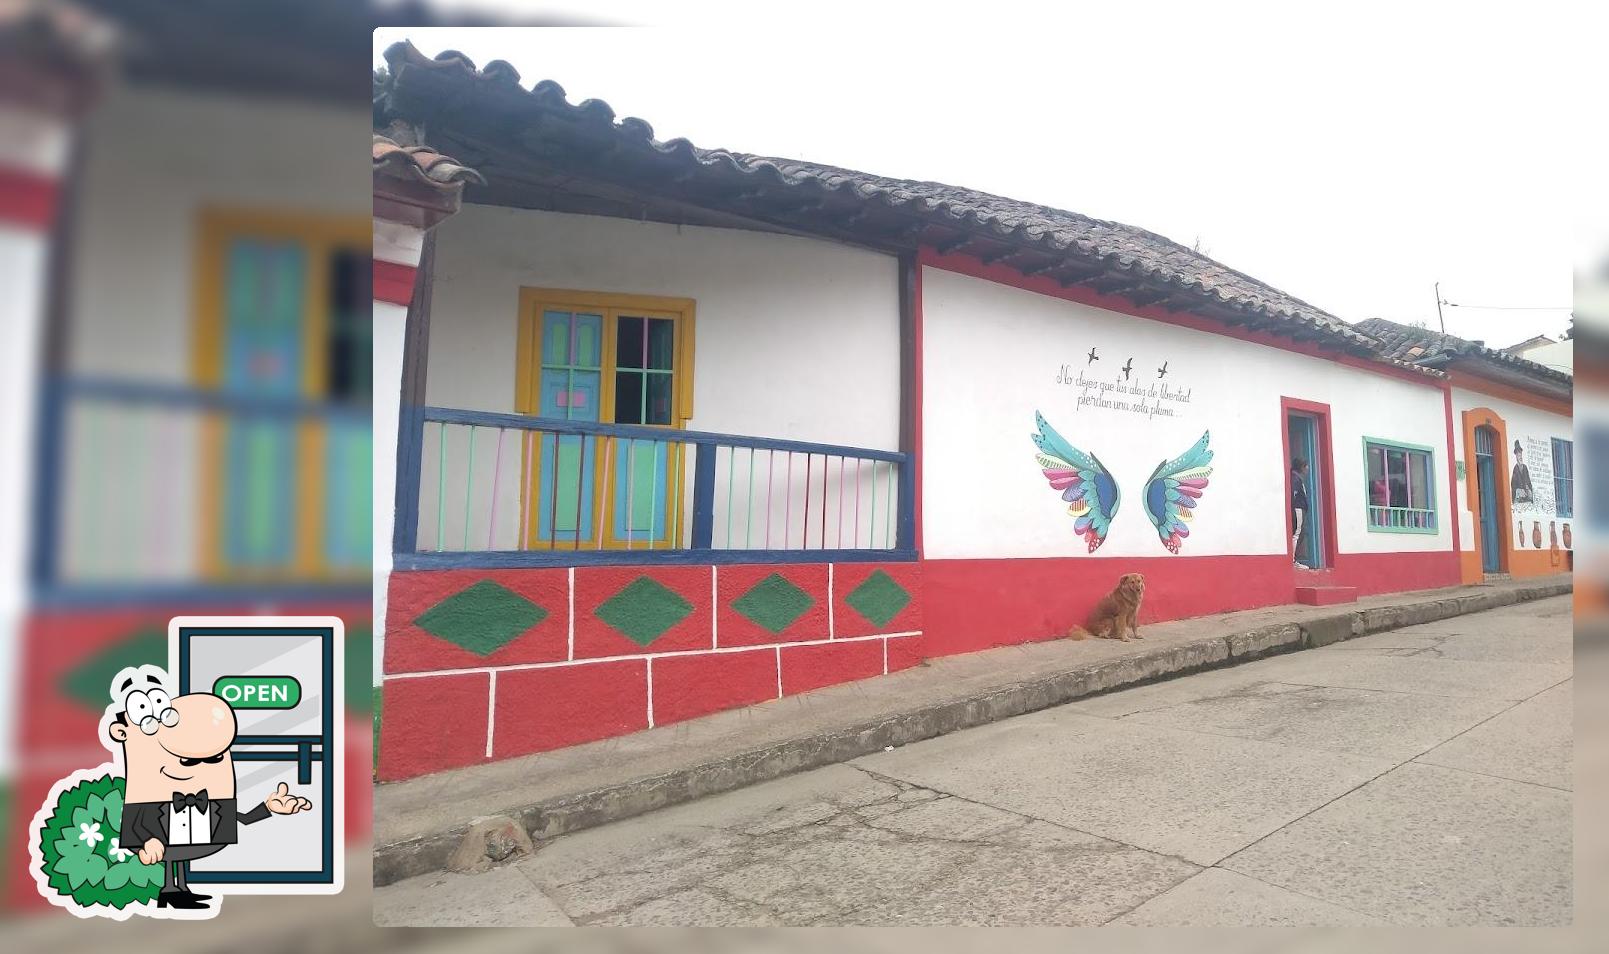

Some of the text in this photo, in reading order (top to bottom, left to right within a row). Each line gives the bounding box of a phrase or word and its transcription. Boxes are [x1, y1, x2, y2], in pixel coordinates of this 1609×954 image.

[1056, 364, 1191, 402] No dejes que tus alas de libertad
[1077, 392, 1111, 411] pierdan
[1114, 400, 1129, 411] una
[1131, 397, 1148, 414] sola
